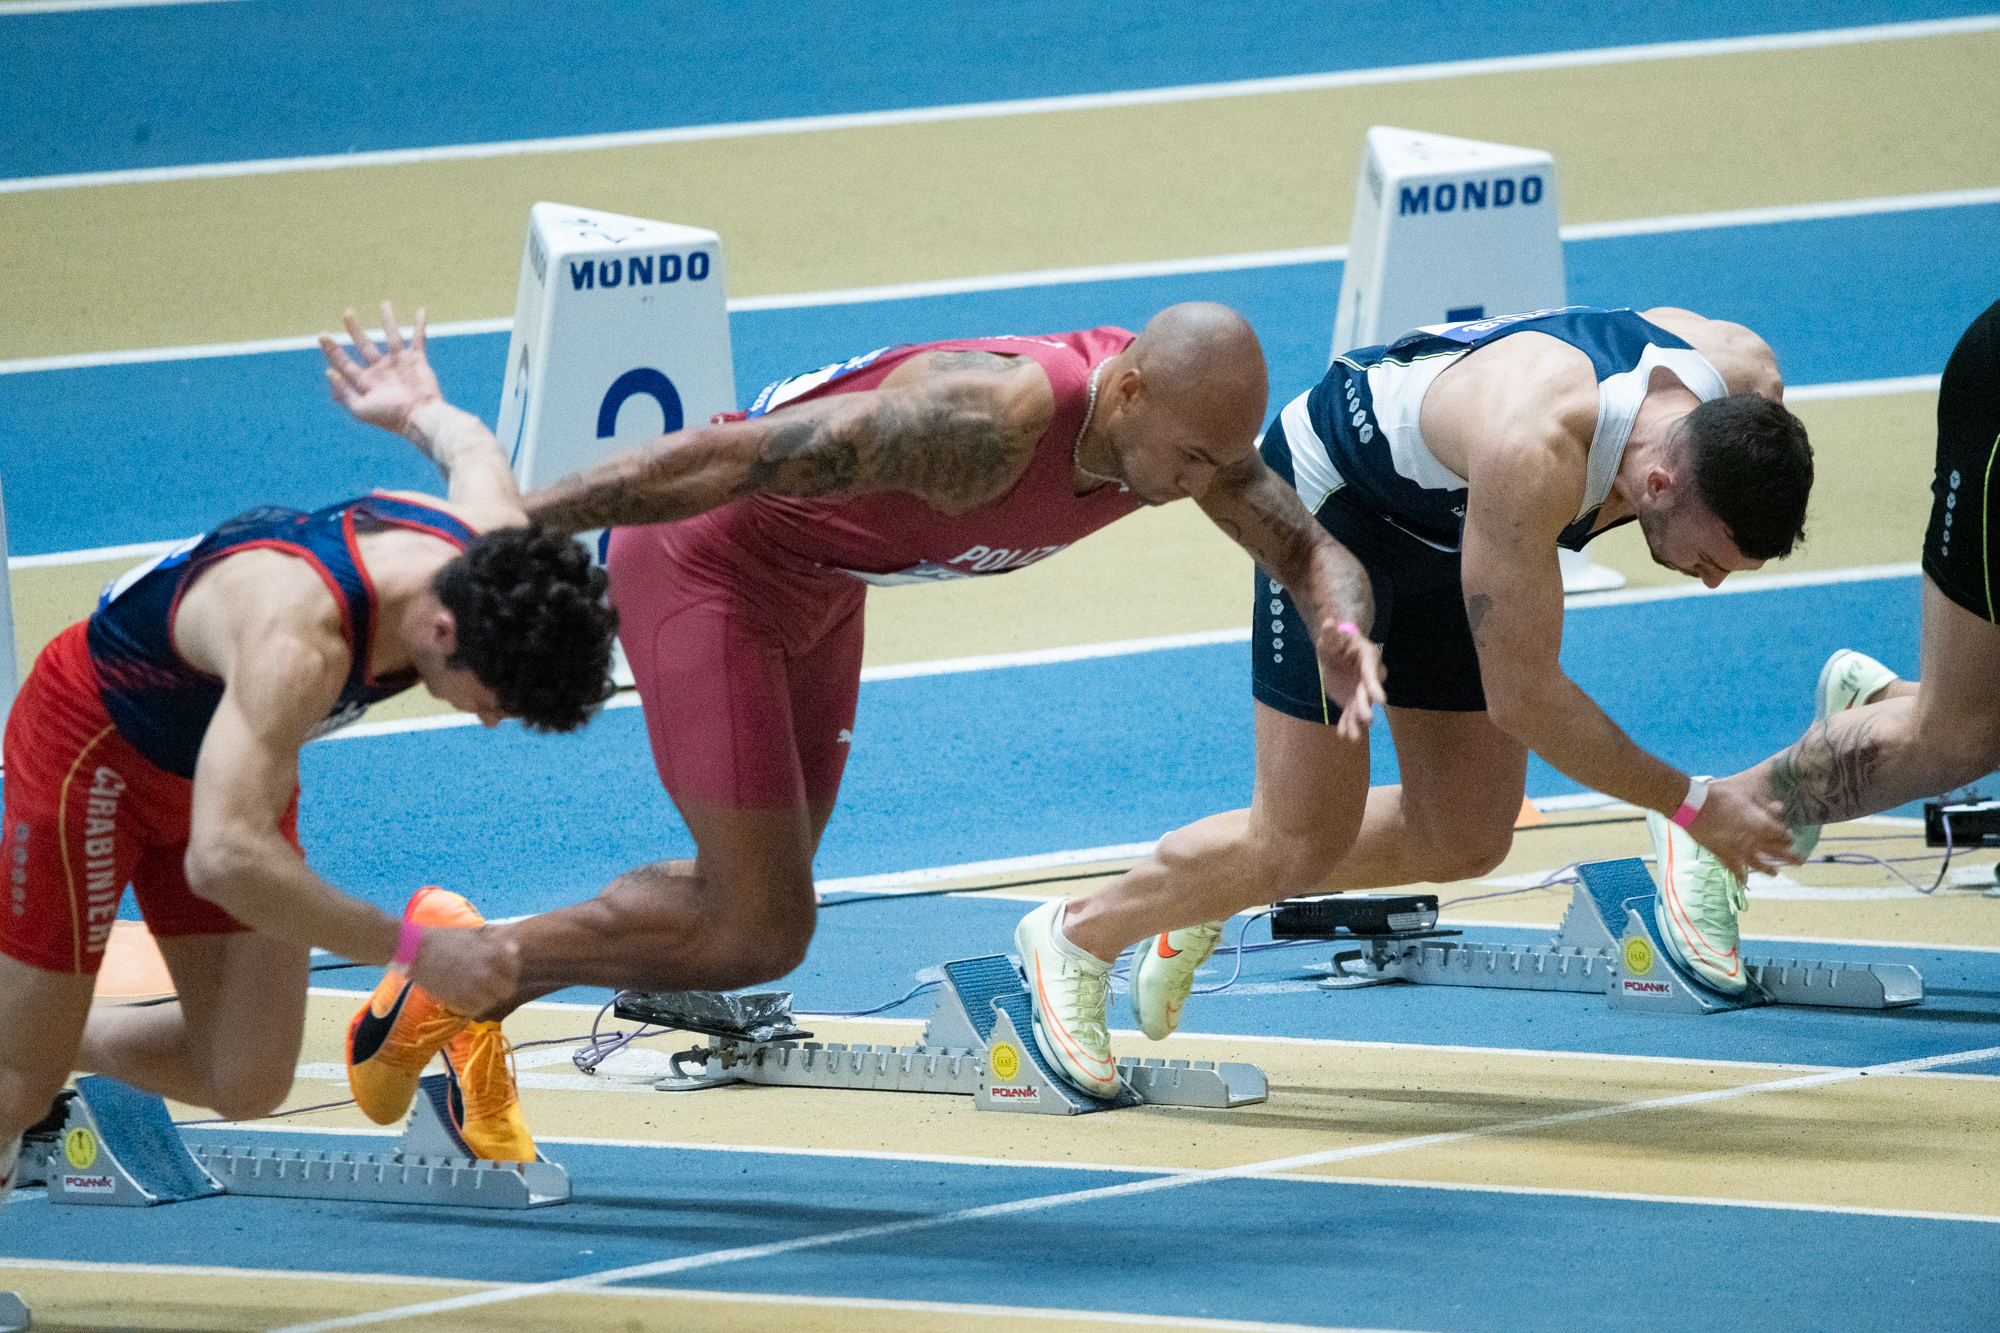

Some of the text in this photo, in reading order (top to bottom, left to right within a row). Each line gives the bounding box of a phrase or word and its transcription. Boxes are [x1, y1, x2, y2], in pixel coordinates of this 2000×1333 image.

[1400, 176, 1543, 216] MONDO
[570, 251, 710, 291] MONDO
[992, 1087, 1038, 1098] POLANIK
